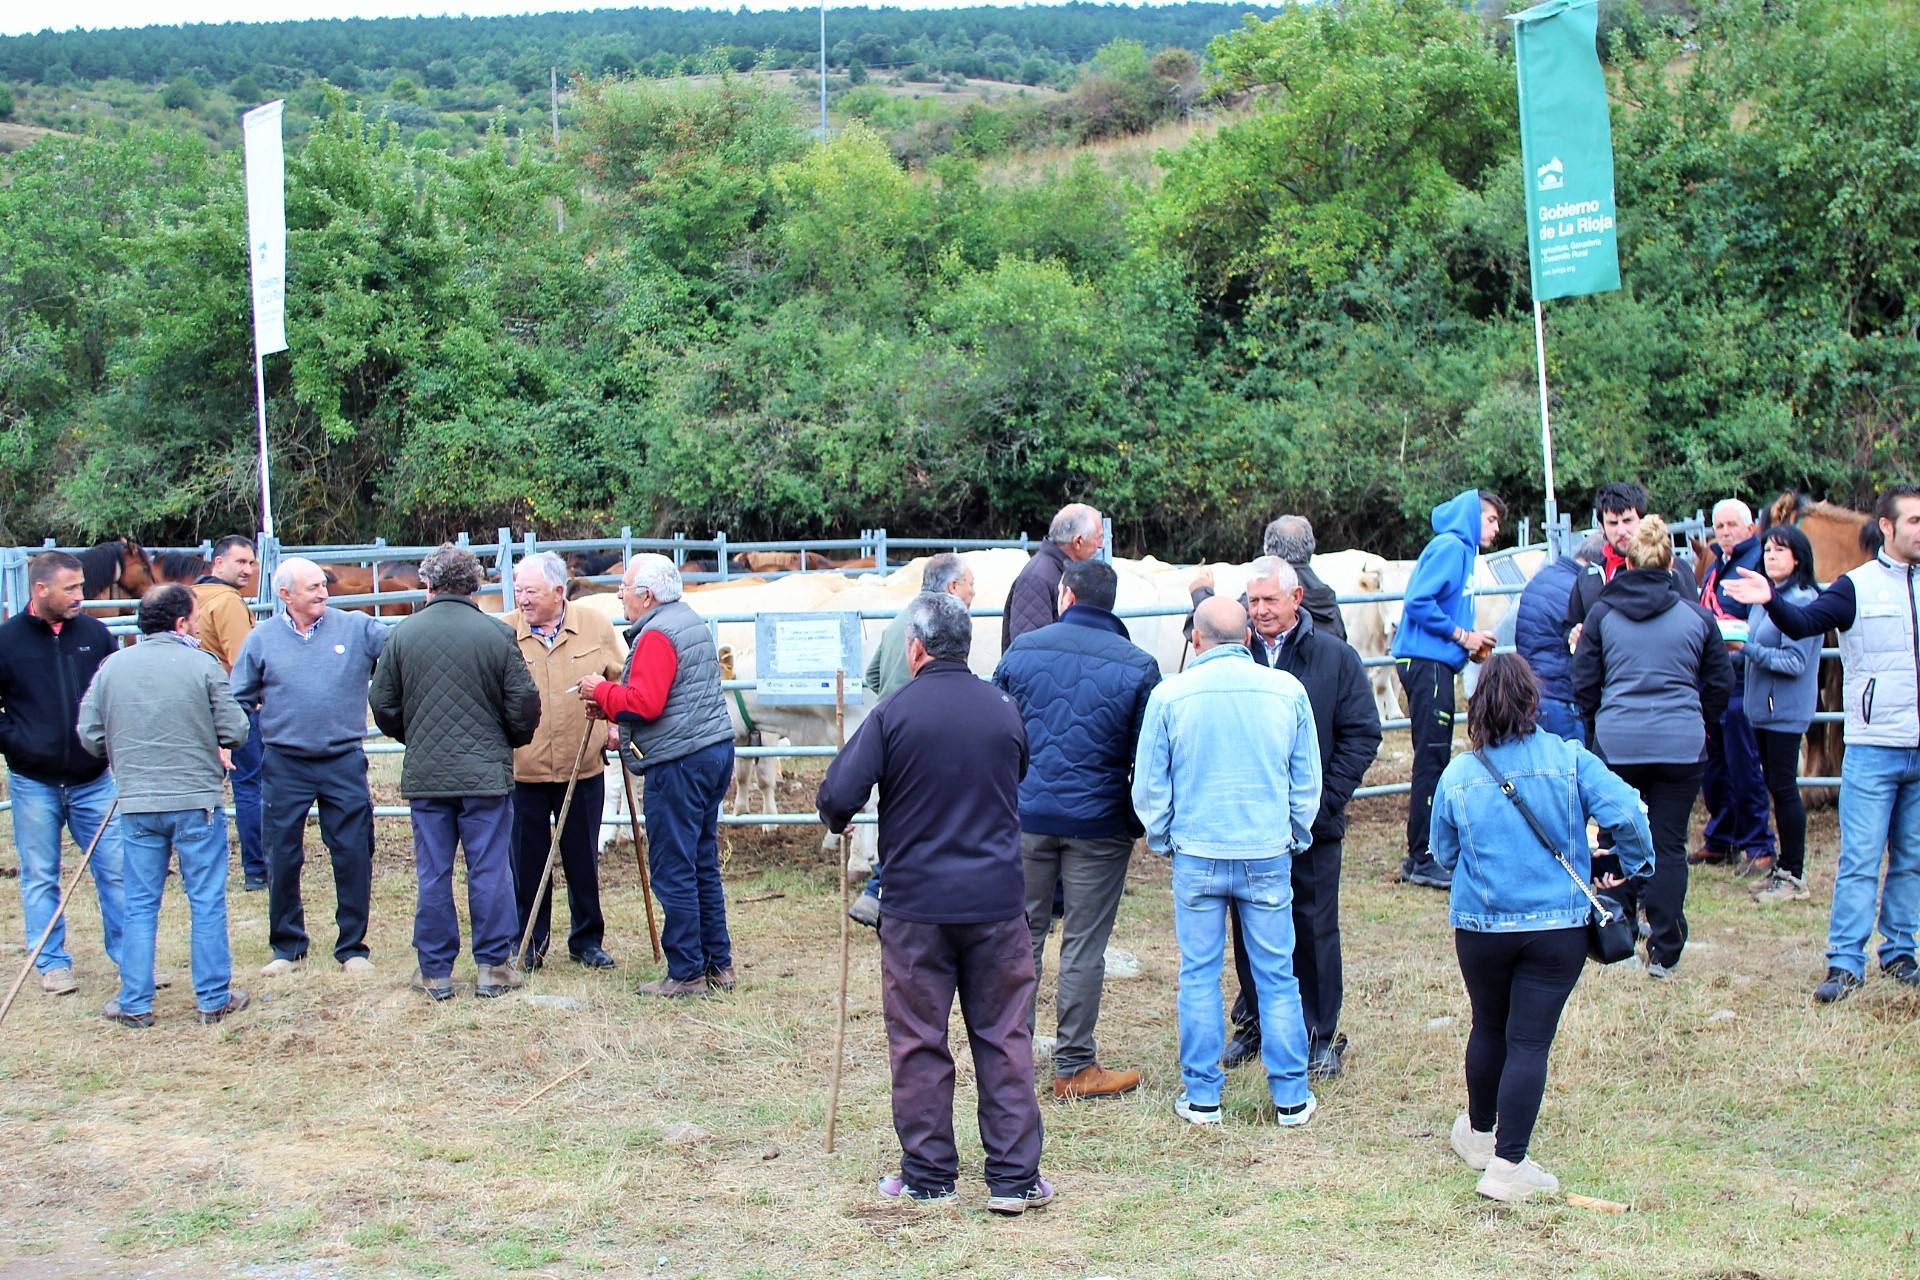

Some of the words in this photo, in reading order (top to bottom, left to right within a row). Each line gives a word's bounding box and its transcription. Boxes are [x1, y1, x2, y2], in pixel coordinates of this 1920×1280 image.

[1539, 200, 1599, 221] Gobierno
[1540, 225, 1555, 240] de
[1559, 222, 1574, 237] La
[1577, 214, 1613, 233] Rioja
